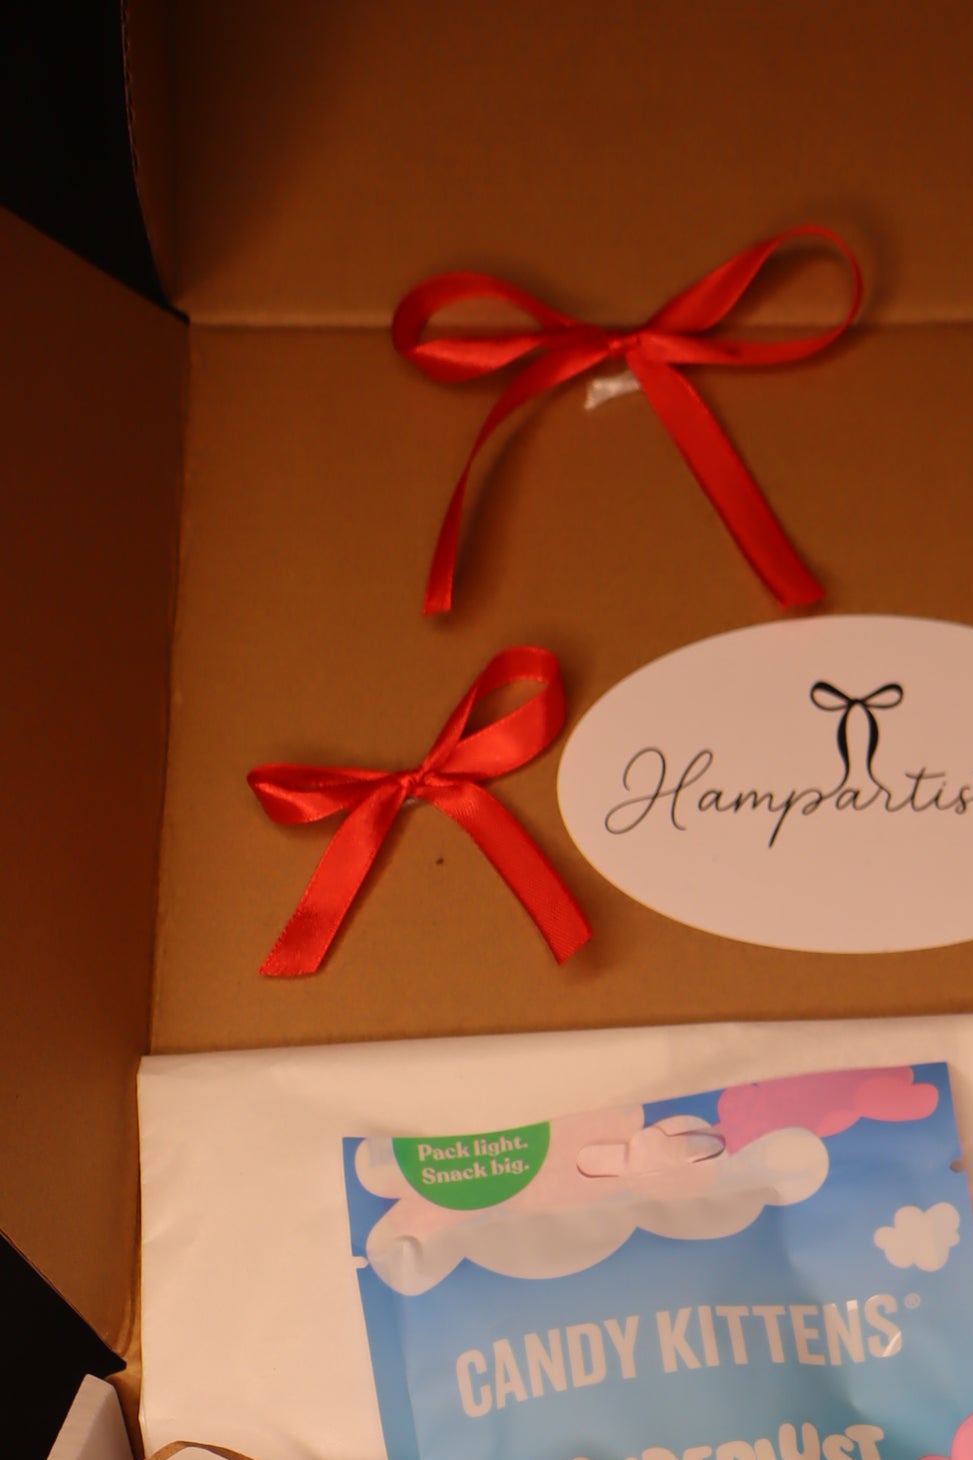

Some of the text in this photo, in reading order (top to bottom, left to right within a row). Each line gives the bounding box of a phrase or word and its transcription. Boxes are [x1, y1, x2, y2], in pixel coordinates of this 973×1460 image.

[417, 1136, 528, 1162] Pack light.
[422, 1157, 530, 1185] Snack big.
[455, 1315, 640, 1418] CANDY
